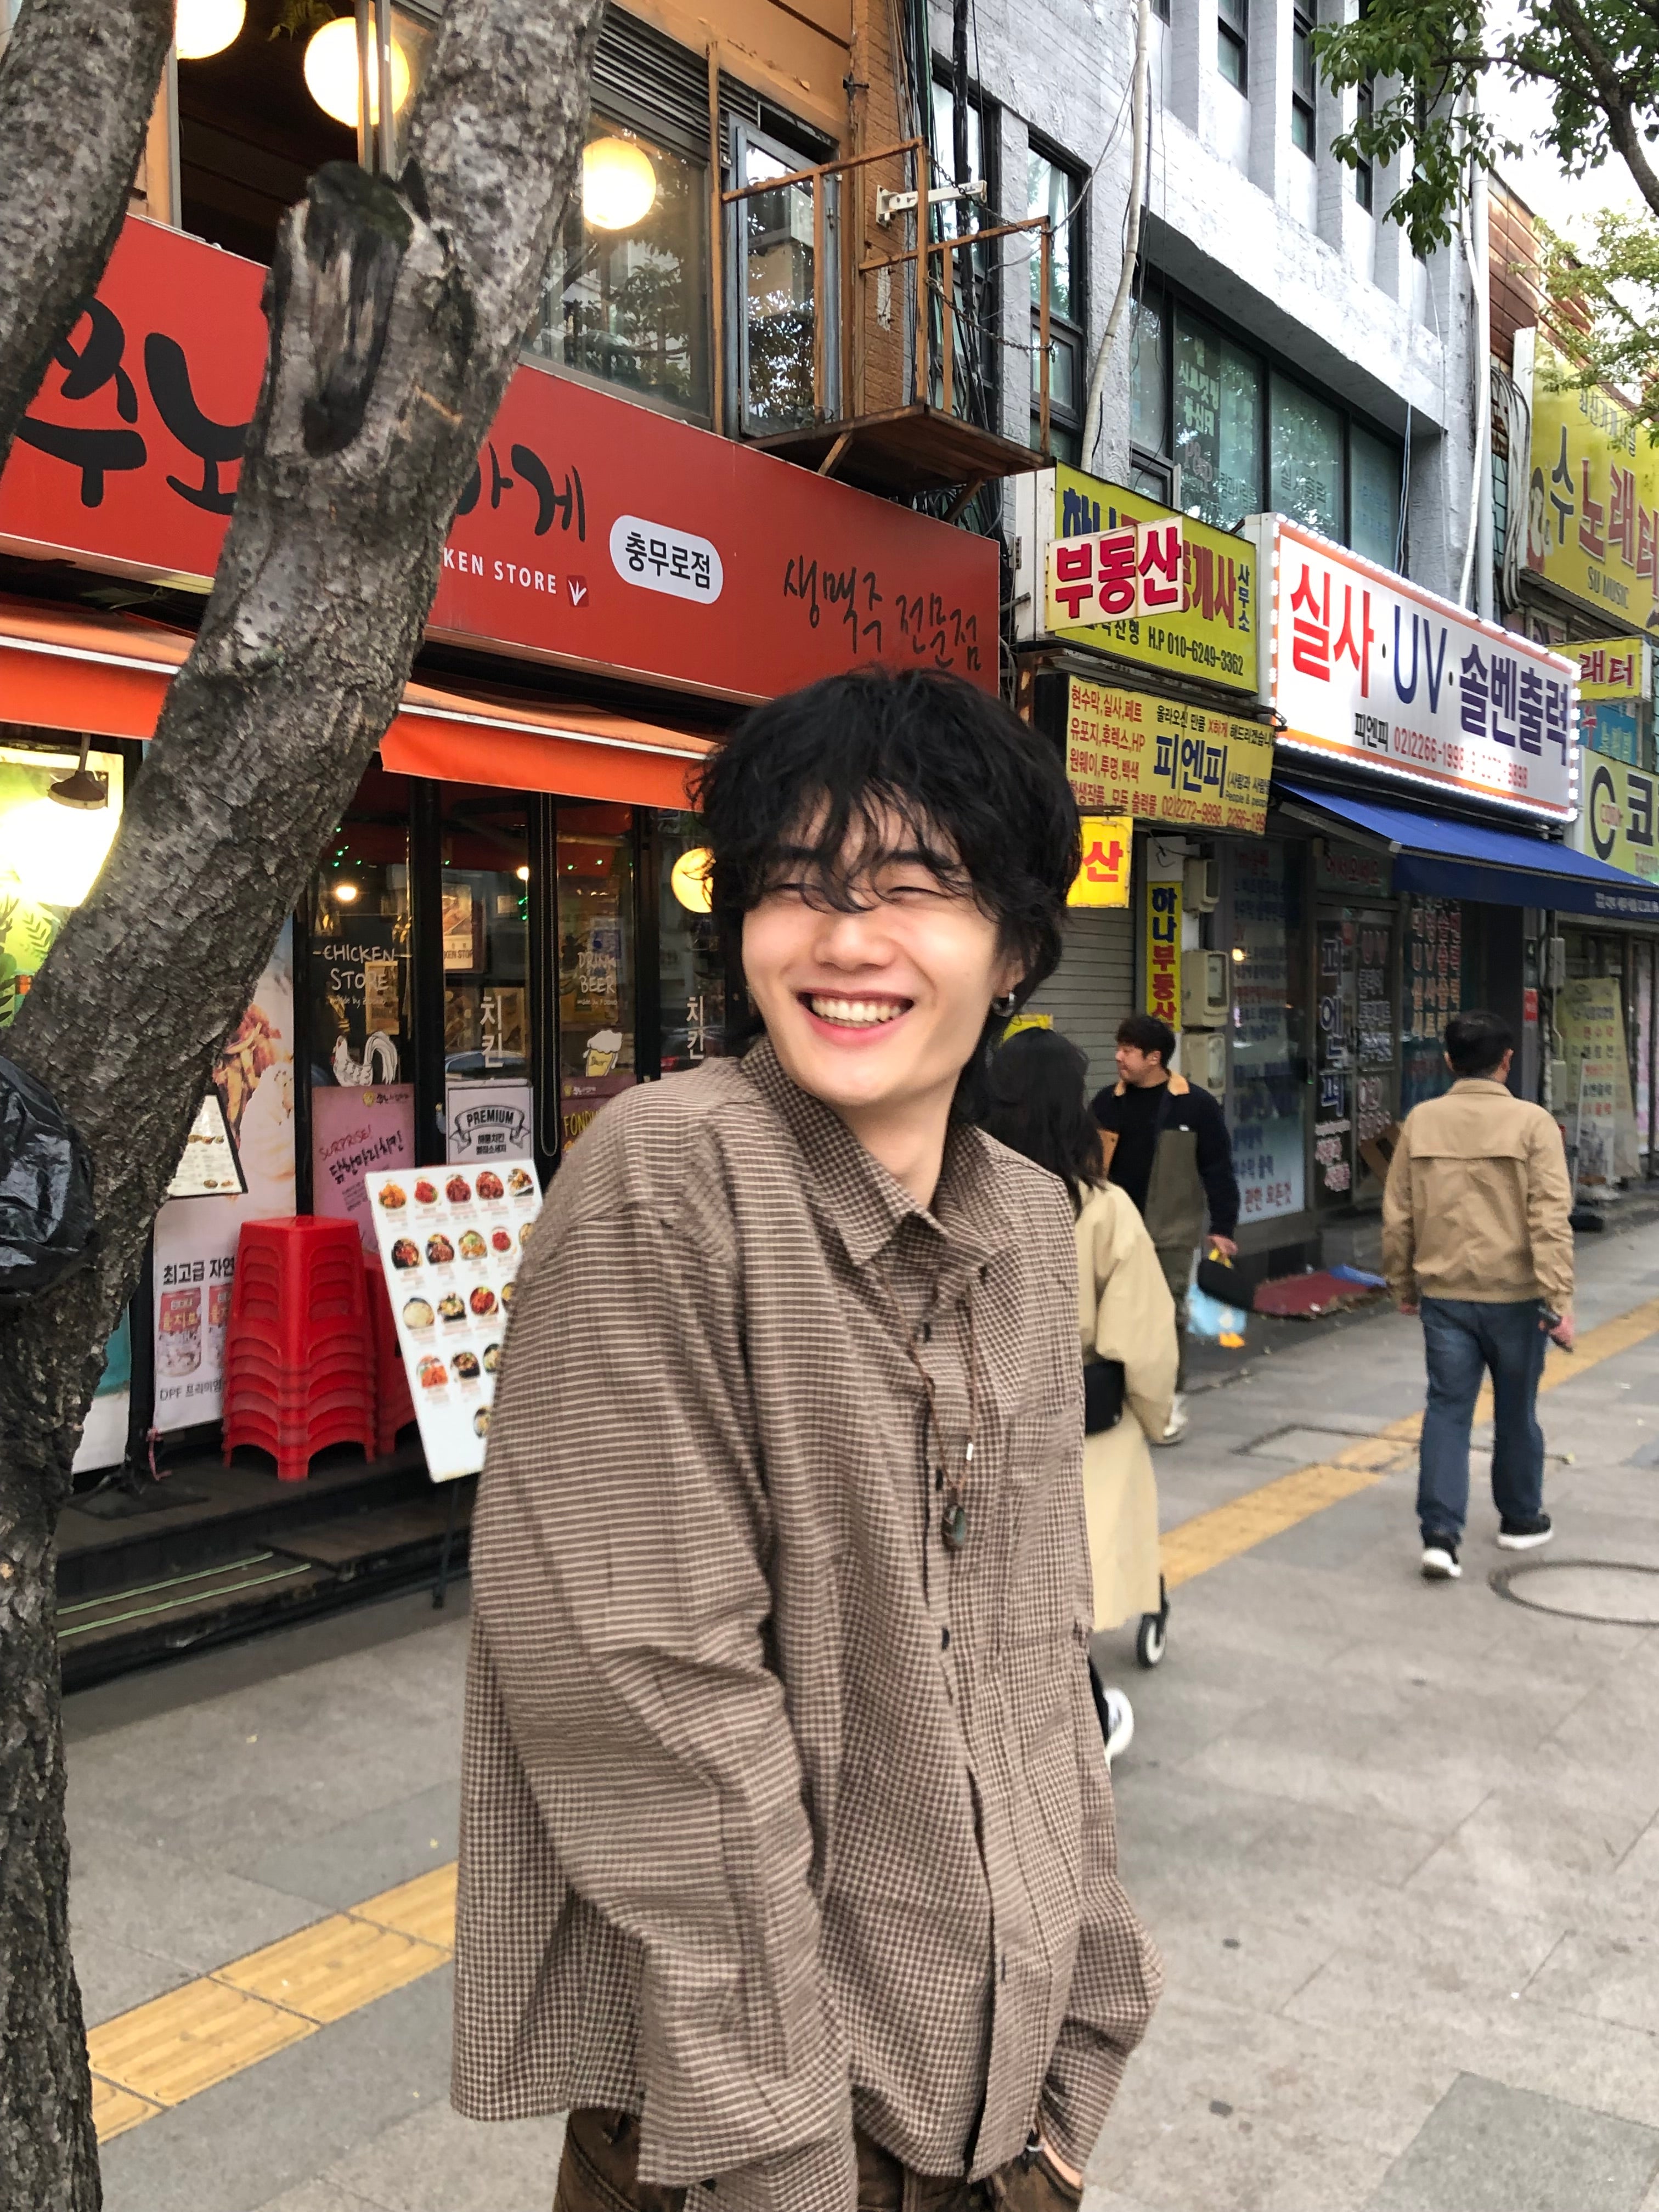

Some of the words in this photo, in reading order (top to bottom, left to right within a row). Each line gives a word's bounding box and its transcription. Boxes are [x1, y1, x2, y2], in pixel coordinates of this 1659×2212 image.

[494, 560, 557, 594] STORE
[625, 531, 711, 590] 충무로점
[1056, 526, 1183, 619] 부동산
[783, 555, 883, 654] 생맥주
[894, 592, 983, 673] 전문점
[1237, 563, 1251, 633] 사무소
[1149, 625, 1164, 652] H.P
[1167, 633, 1243, 676] 010-6249-3362
[1355, 712, 1389, 753] 피엔피
[1153, 733, 1228, 798] 피엔피
[1626, 771, 1659, 848] 코
[1083, 840, 1124, 883] 산
[323, 944, 396, 964] CHICKEN
[577, 951, 617, 969] DRINK
[330, 967, 390, 991] STORE
[579, 975, 616, 994] BEER
[479, 995, 504, 1069] 치킨
[686, 996, 704, 1060] 치킨
[466, 1109, 514, 1127] PREMIUM
[563, 1110, 598, 1137] FOND
[318, 1124, 374, 1161] SURPRISE!
[163, 1260, 205, 1286] 최고급
[210, 1256, 235, 1278] 자연
